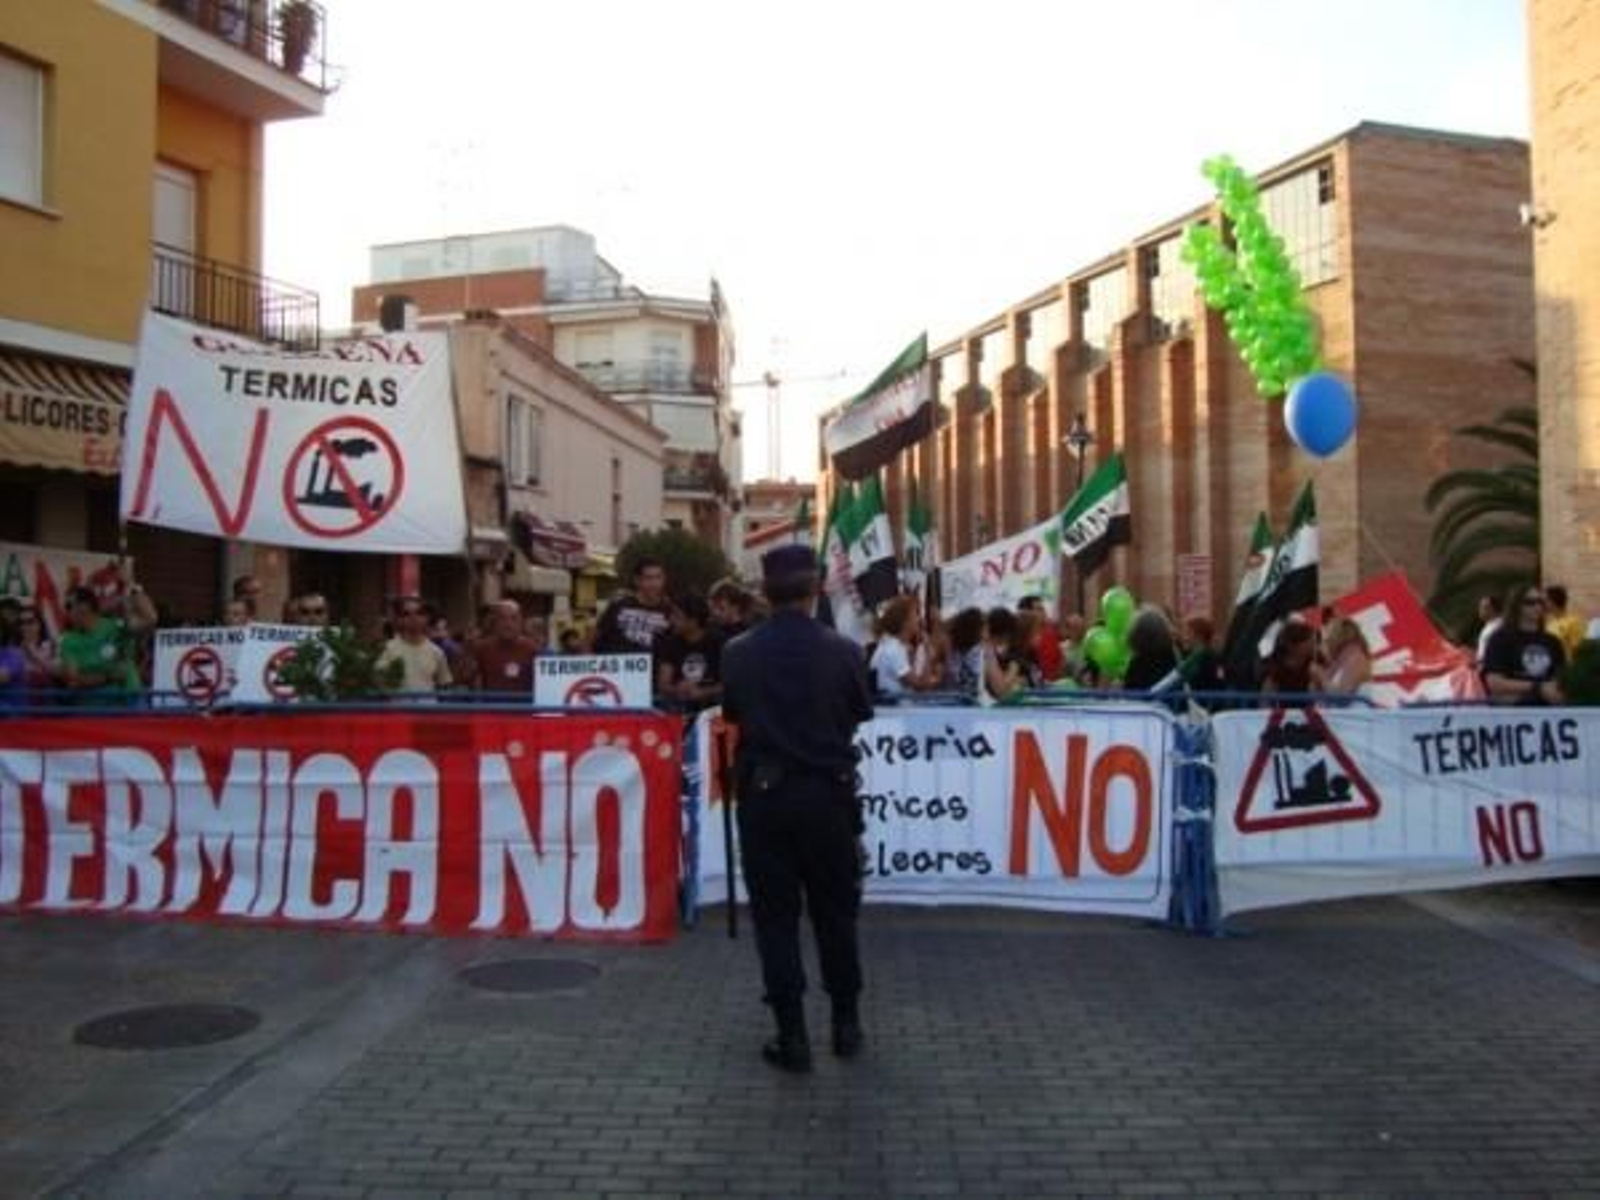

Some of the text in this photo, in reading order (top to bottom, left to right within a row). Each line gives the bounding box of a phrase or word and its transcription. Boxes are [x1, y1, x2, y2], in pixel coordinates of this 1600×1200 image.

[219, 365, 398, 407] TERMICAS
[4, 391, 110, 435] LICORES
[980, 540, 1042, 586] NO
[159, 629, 244, 645] TERMICAS NO
[539, 657, 648, 674] TERMICAS NO
[1413, 717, 1580, 776] TÉRMICAS
[858, 790, 968, 823] micas
[1008, 728, 1152, 879] NO
[0, 745, 440, 924] TERMICA
[470, 748, 646, 931] NO
[1476, 801, 1544, 867] NO
